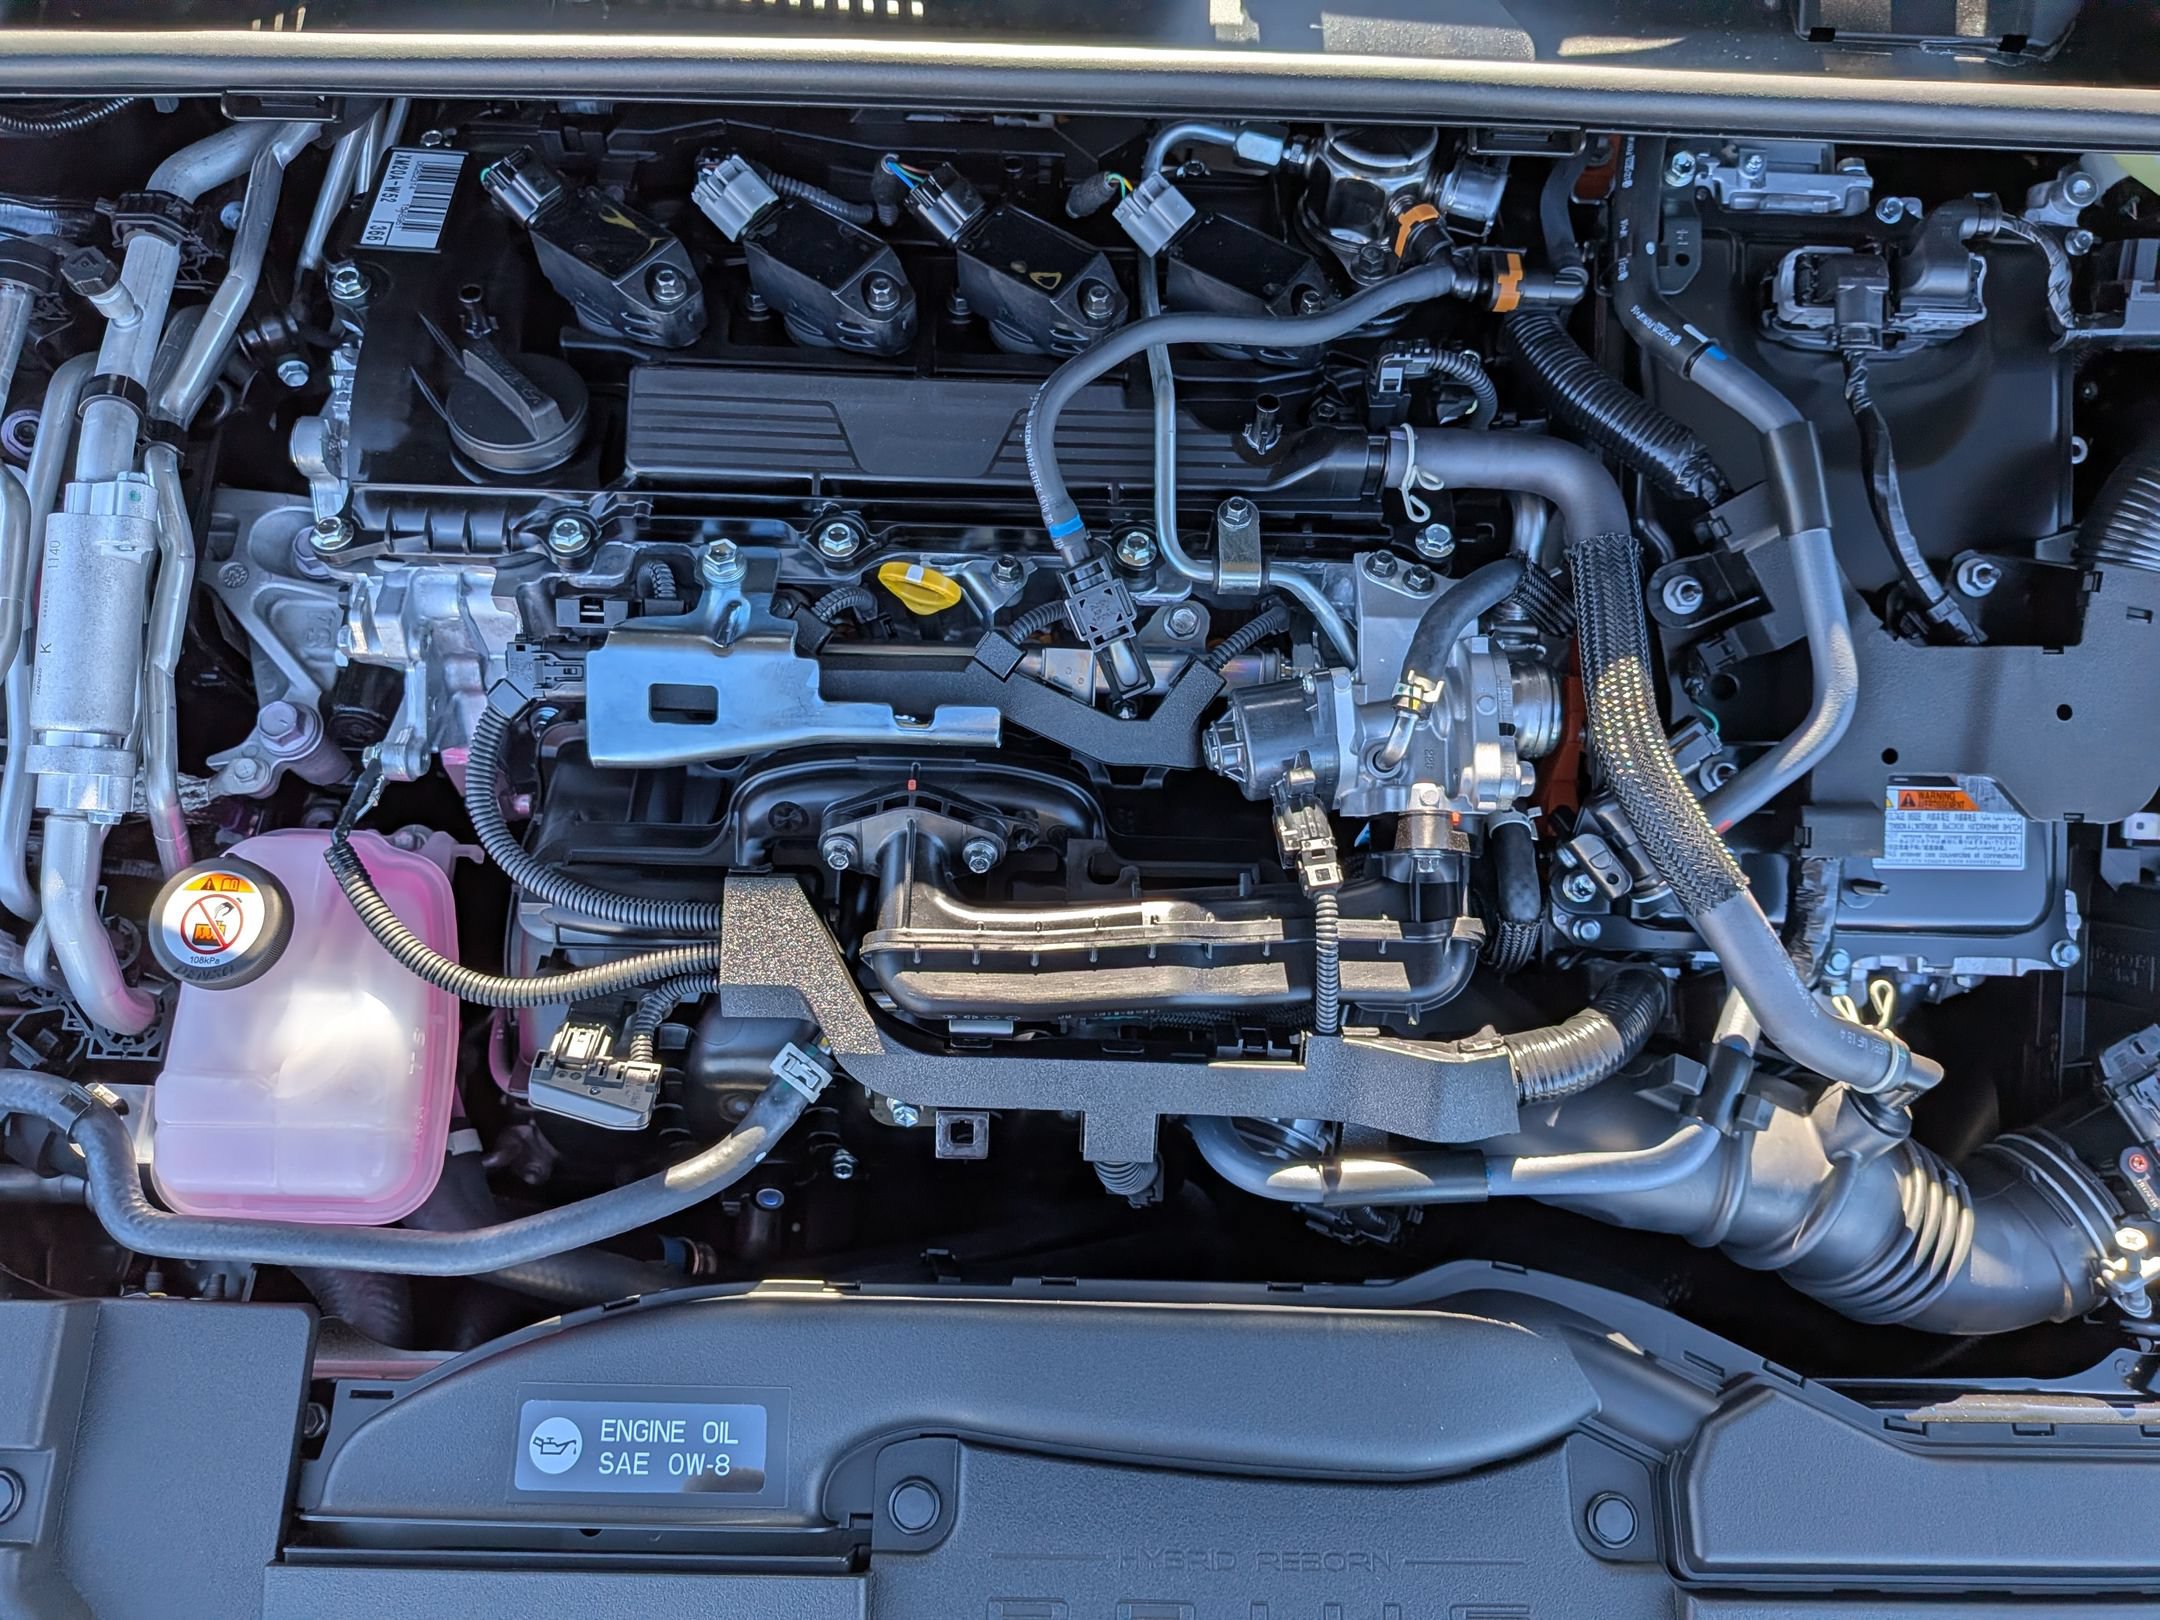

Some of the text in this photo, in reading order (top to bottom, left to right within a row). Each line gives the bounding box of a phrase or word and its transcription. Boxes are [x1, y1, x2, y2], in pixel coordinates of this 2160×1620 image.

[380, 154, 413, 203] XM20A-W52
[366, 225, 388, 241] 366
[48, 540, 61, 569] 1140
[40, 642, 52, 654] K
[1919, 791, 1956, 800] WARNING
[190, 956, 220, 964] 108kPa
[601, 1419, 738, 1444] ENGINE OIL
[599, 1452, 730, 1476] SAE 0W-8
[1118, 1548, 1391, 1573] HYBRID REBORN
